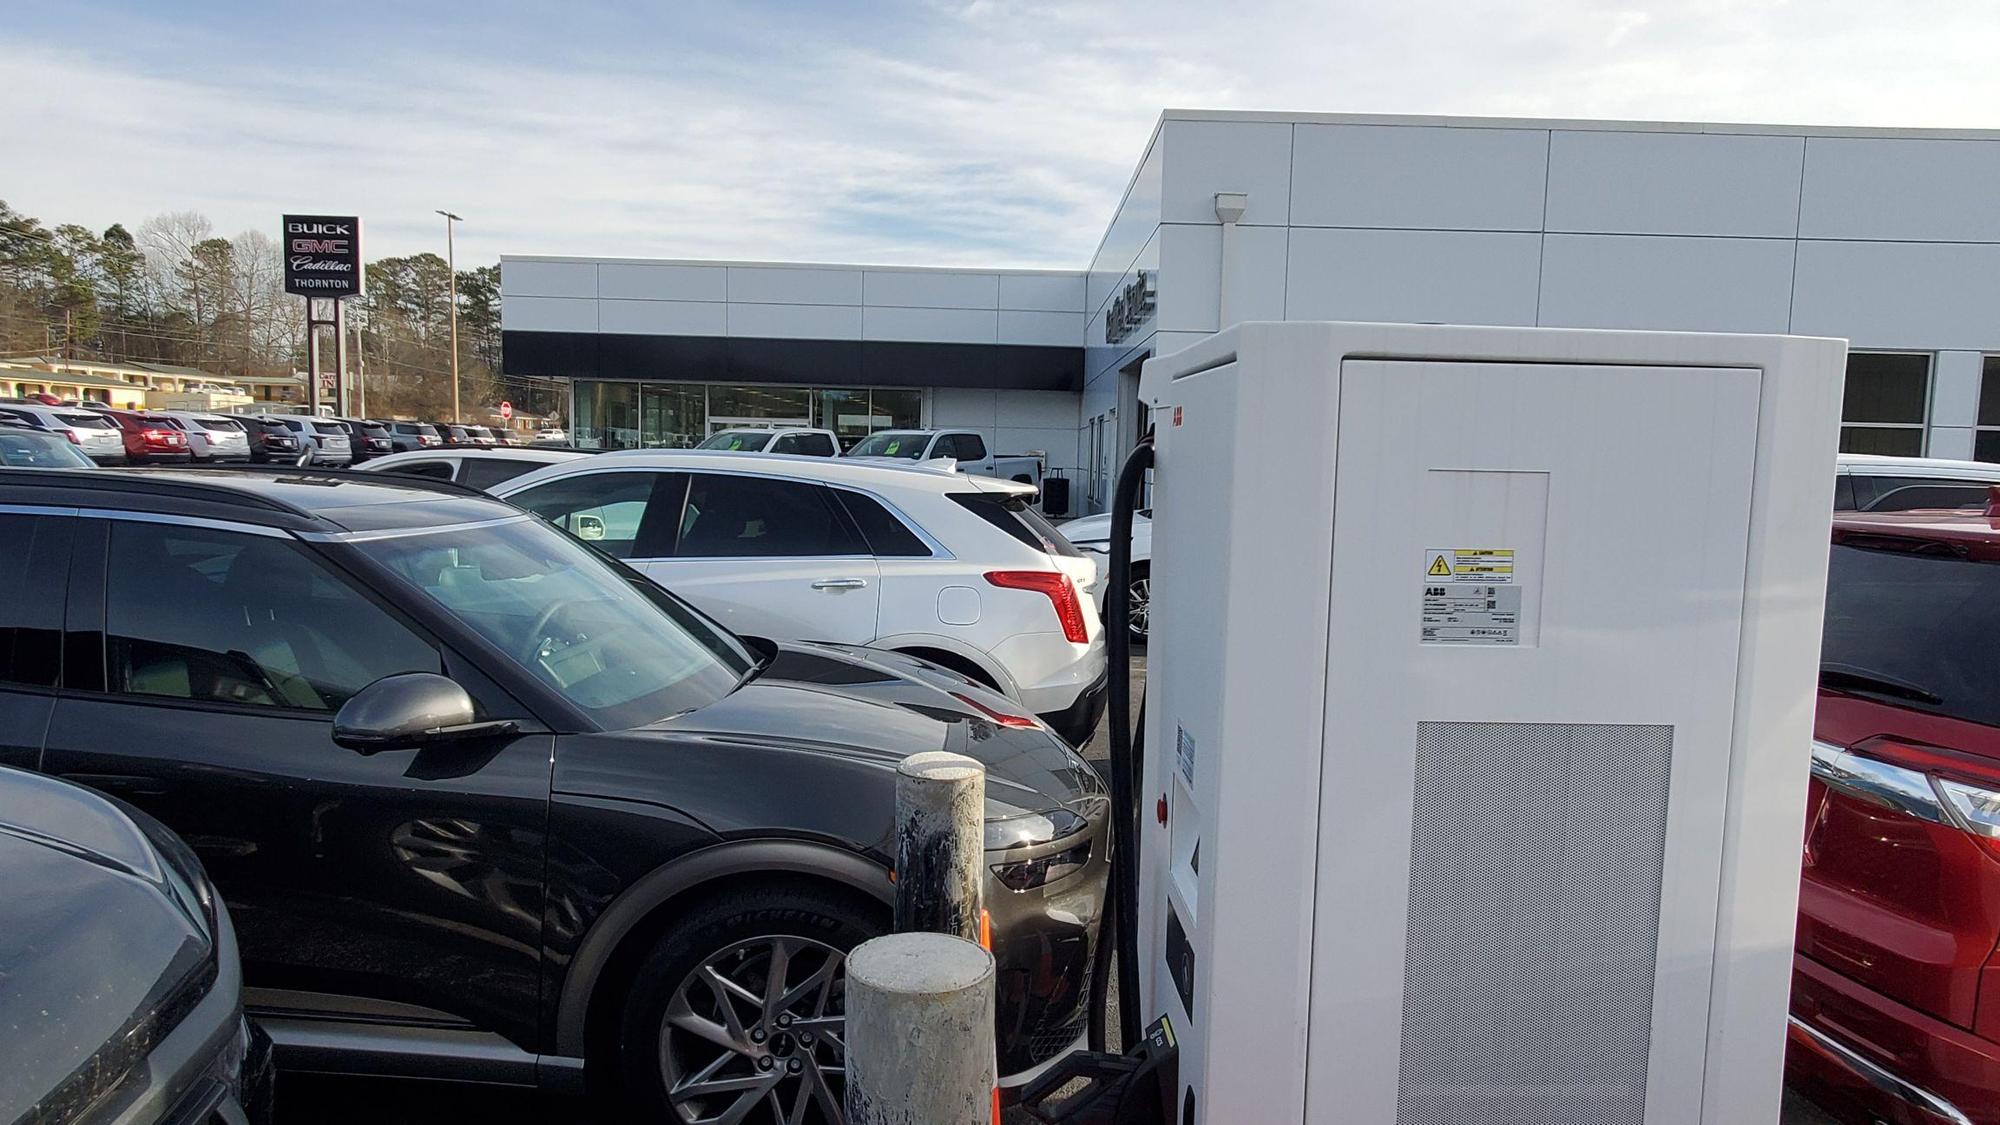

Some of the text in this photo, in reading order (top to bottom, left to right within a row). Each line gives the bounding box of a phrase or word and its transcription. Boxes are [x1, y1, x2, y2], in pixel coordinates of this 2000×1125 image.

[288, 223, 350, 235] BUICK
[292, 238, 349, 254] GMC
[290, 255, 352, 272] Cadillac
[294, 278, 349, 289] THORNTON
[1424, 587, 1446, 597] ABB
